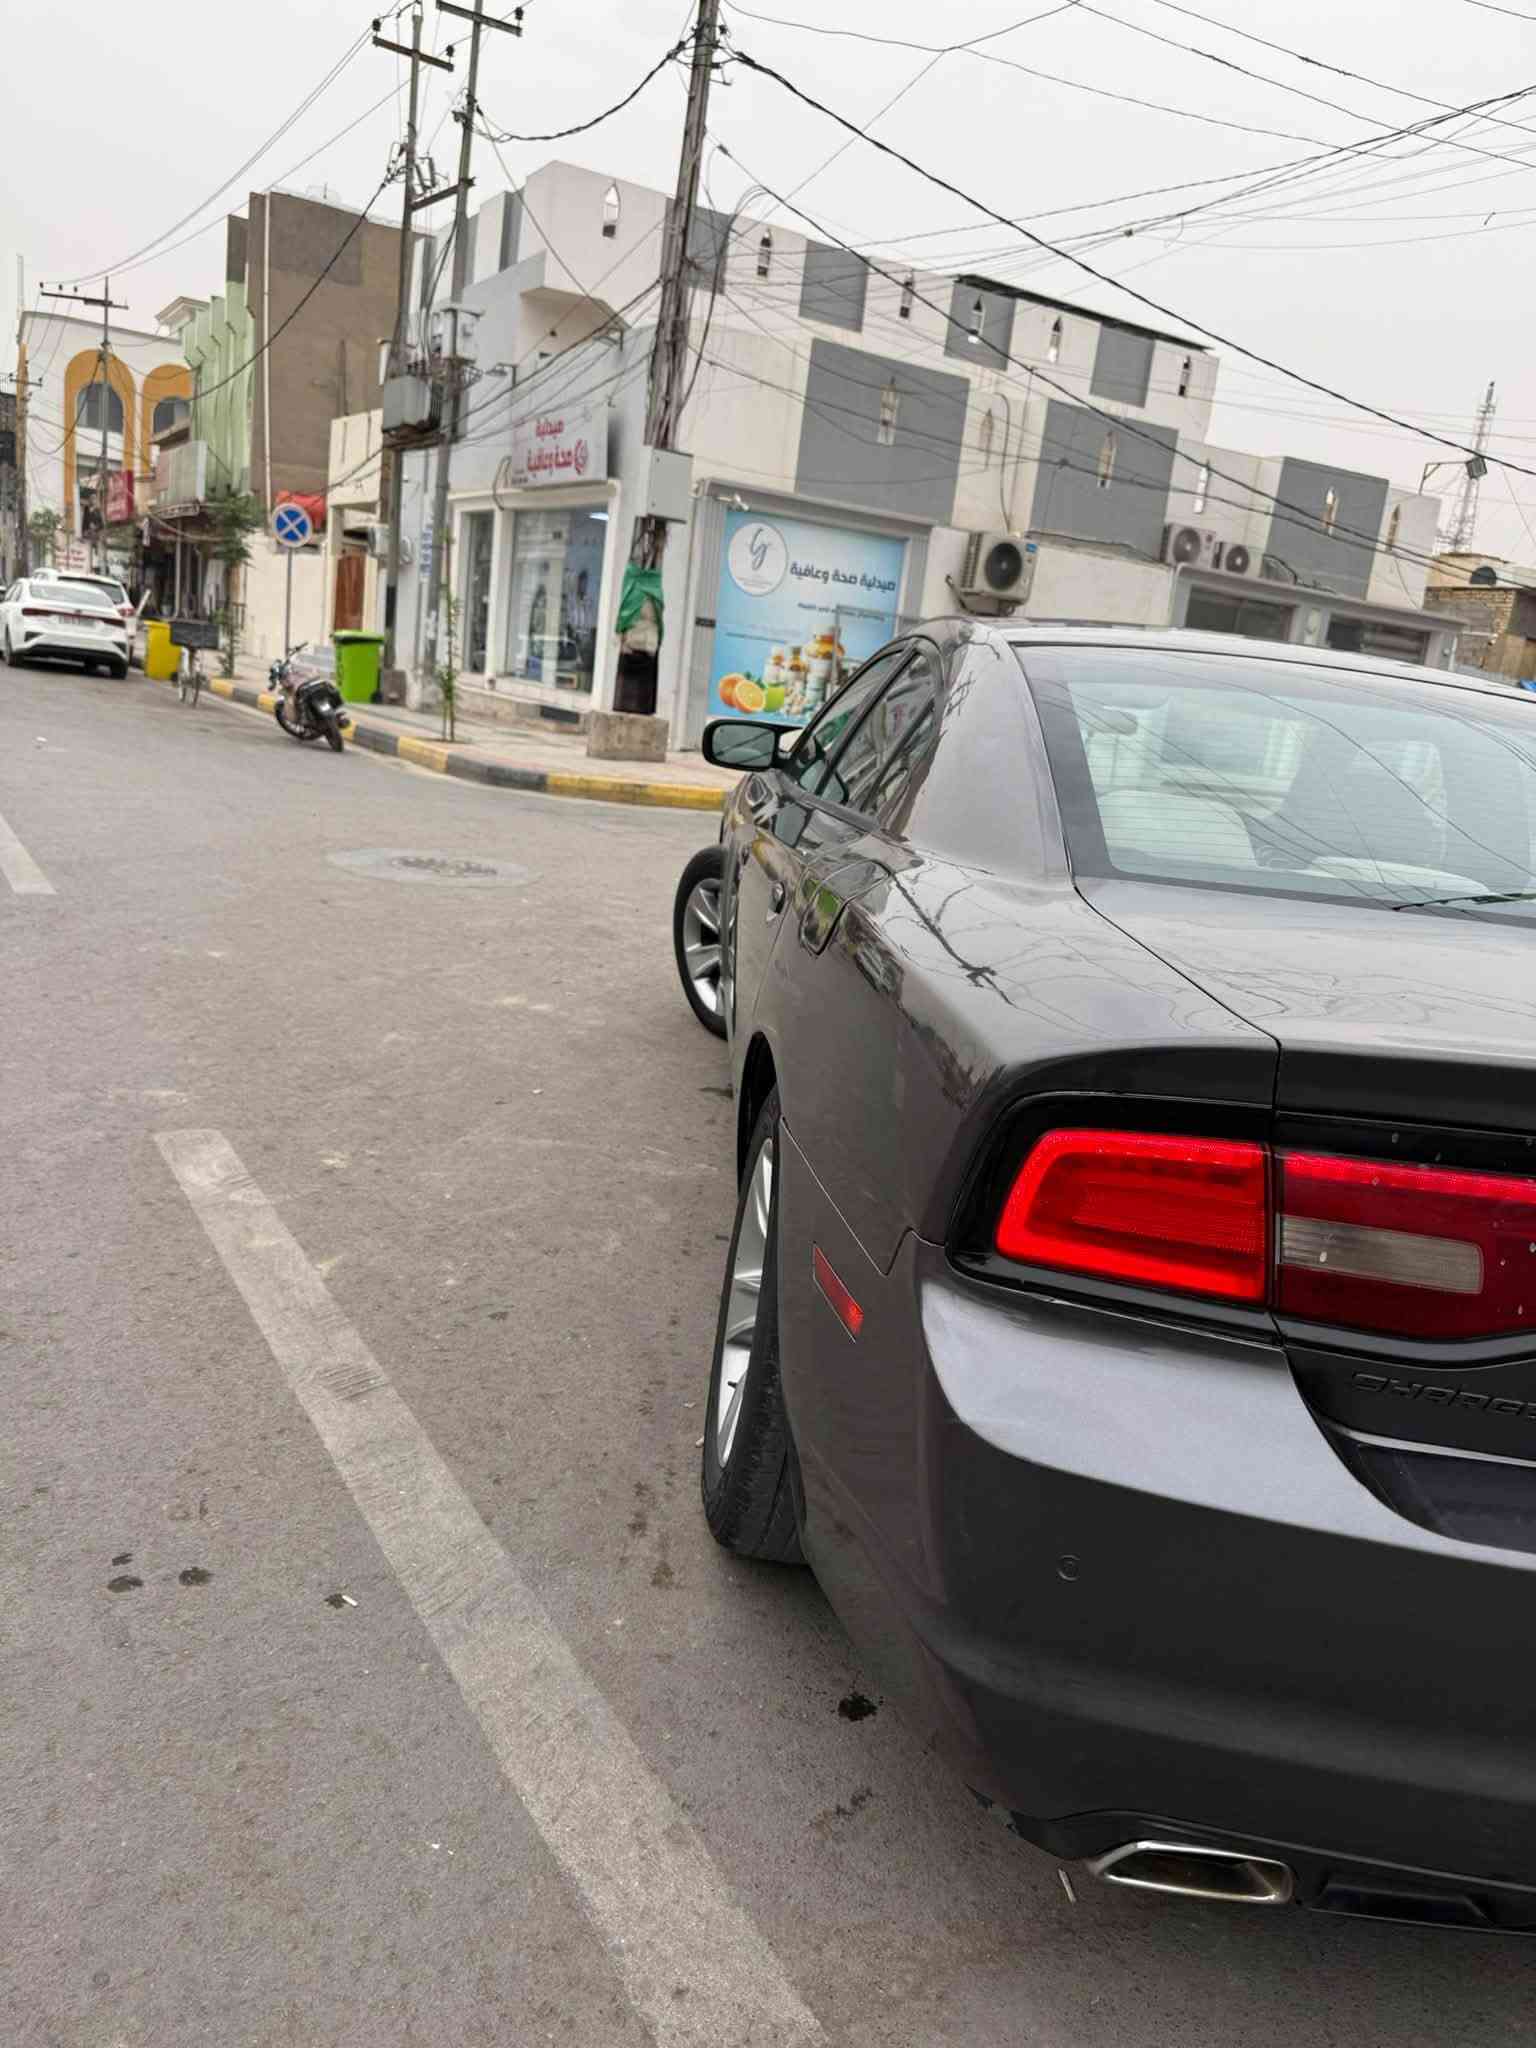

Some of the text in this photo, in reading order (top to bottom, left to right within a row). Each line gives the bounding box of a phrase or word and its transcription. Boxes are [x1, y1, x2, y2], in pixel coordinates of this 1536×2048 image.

[790, 561, 830, 584] وعافية
[831, 571, 858, 587] صحة
[860, 574, 897, 592] صيدلية
